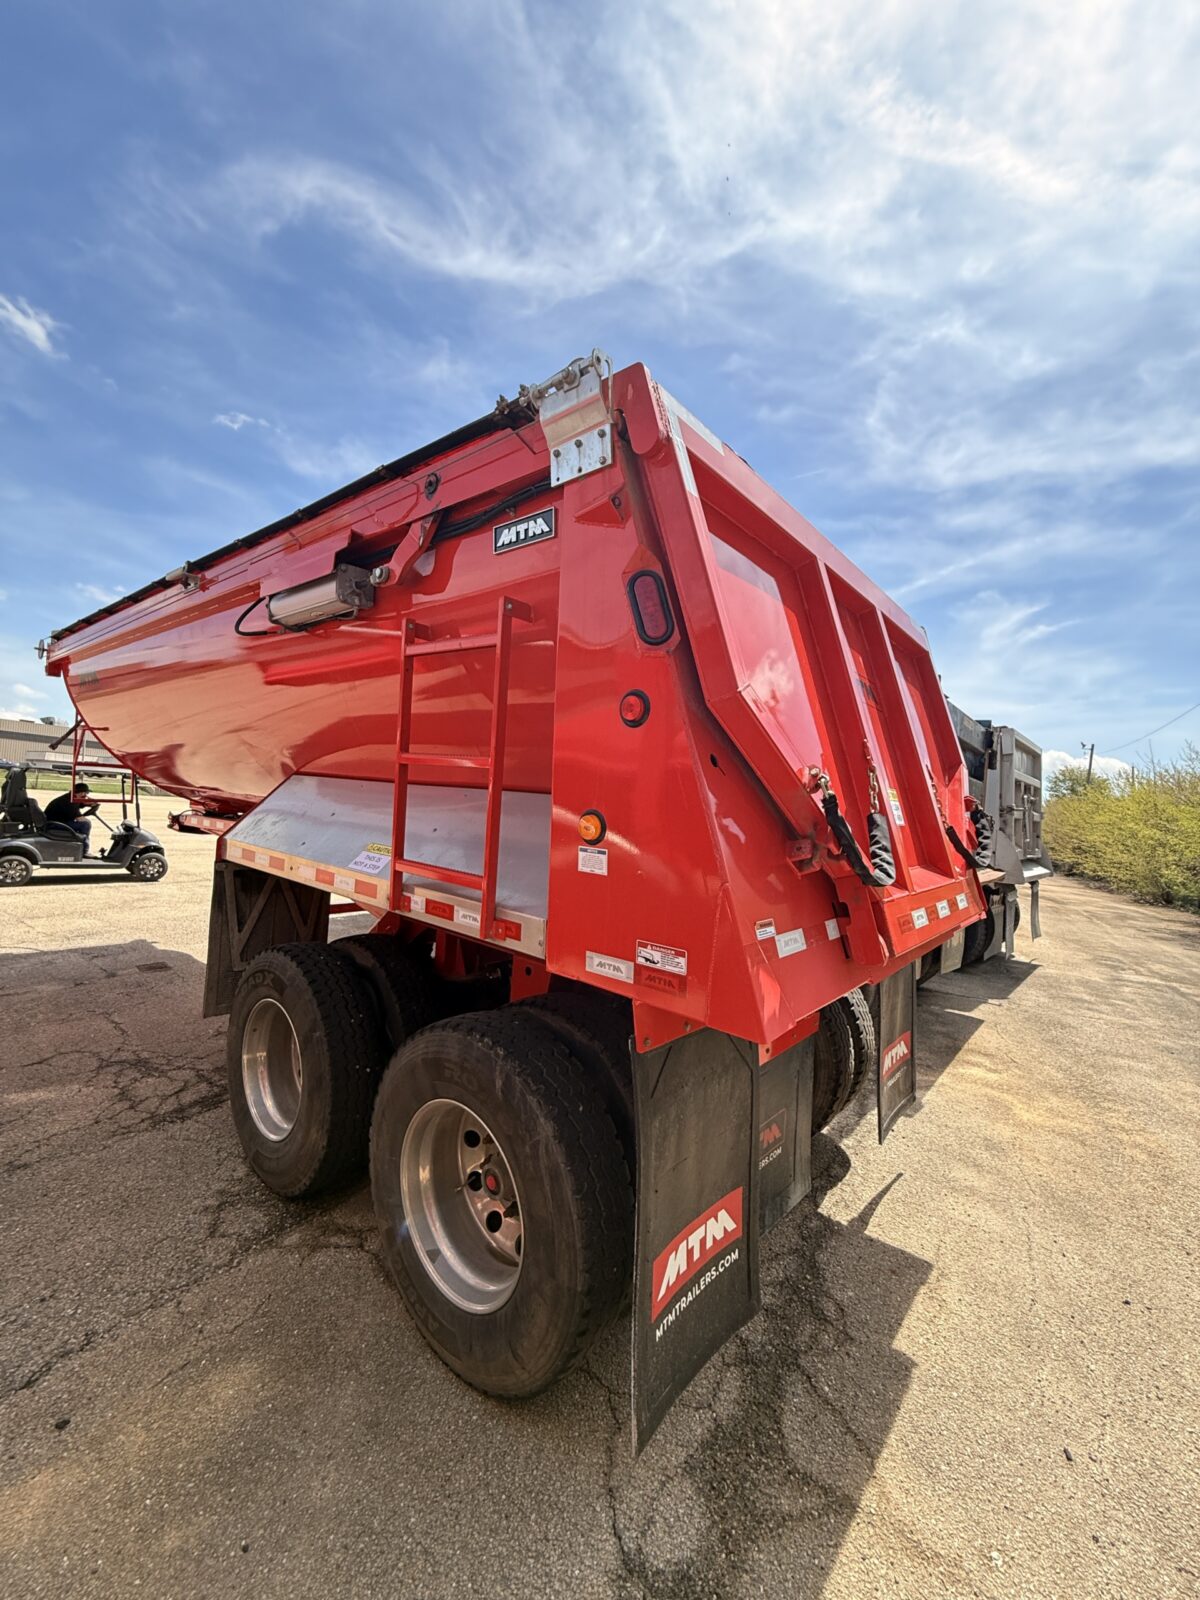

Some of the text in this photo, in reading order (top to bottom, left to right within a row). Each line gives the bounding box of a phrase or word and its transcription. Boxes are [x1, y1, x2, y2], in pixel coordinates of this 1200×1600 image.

[496, 517, 551, 547] MTM
[461, 913, 479, 923] MTM
[596, 961, 623, 975] MTM
[644, 974, 676, 989] MTM
[883, 1040, 908, 1076] MTM
[657, 1208, 737, 1302] MTM
[655, 1248, 739, 1342] MTMTRAILERS.COM
